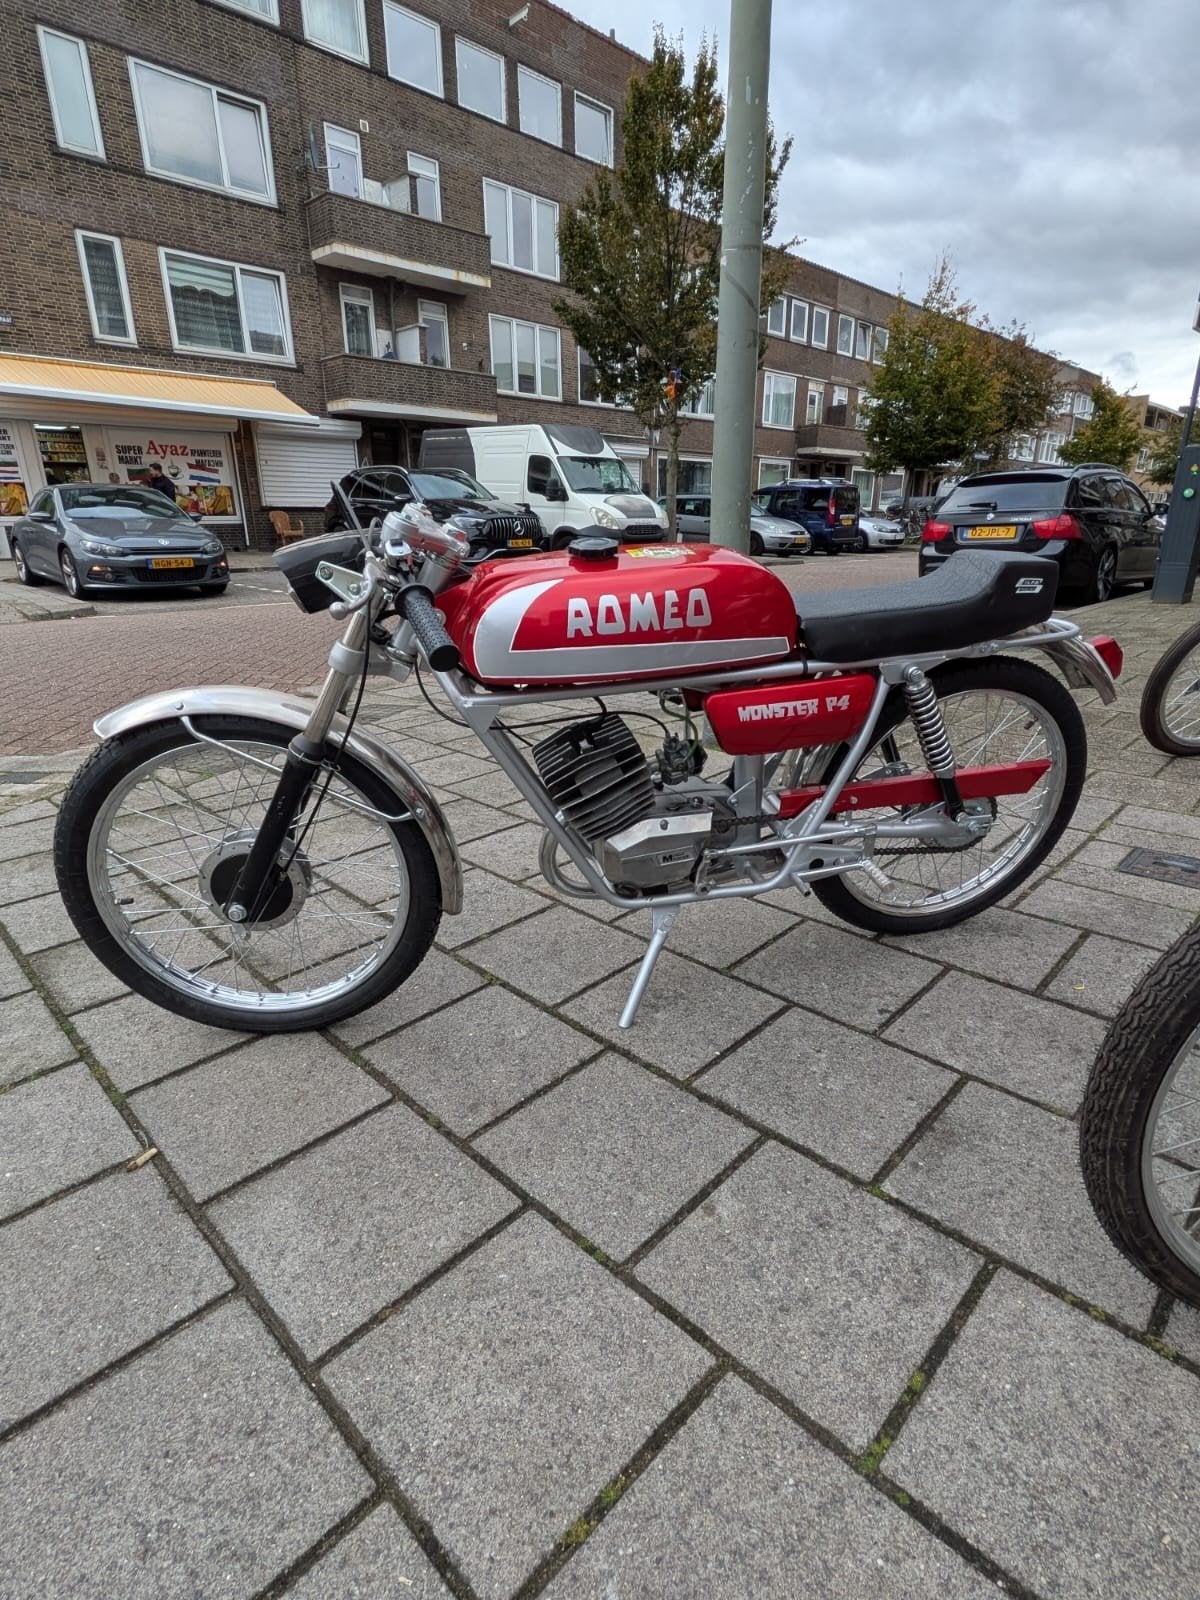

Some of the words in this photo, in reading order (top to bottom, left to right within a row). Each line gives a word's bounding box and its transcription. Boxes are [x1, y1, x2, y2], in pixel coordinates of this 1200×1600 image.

[115, 444, 143, 455] SUPER
[146, 440, 189, 459] Ayaz
[118, 455, 143, 465] MARKT
[971, 527, 1011, 537] 02-JPL-7
[567, 588, 712, 638] ROMEO
[738, 698, 819, 722] MONSTER
[825, 694, 850, 712] P4
